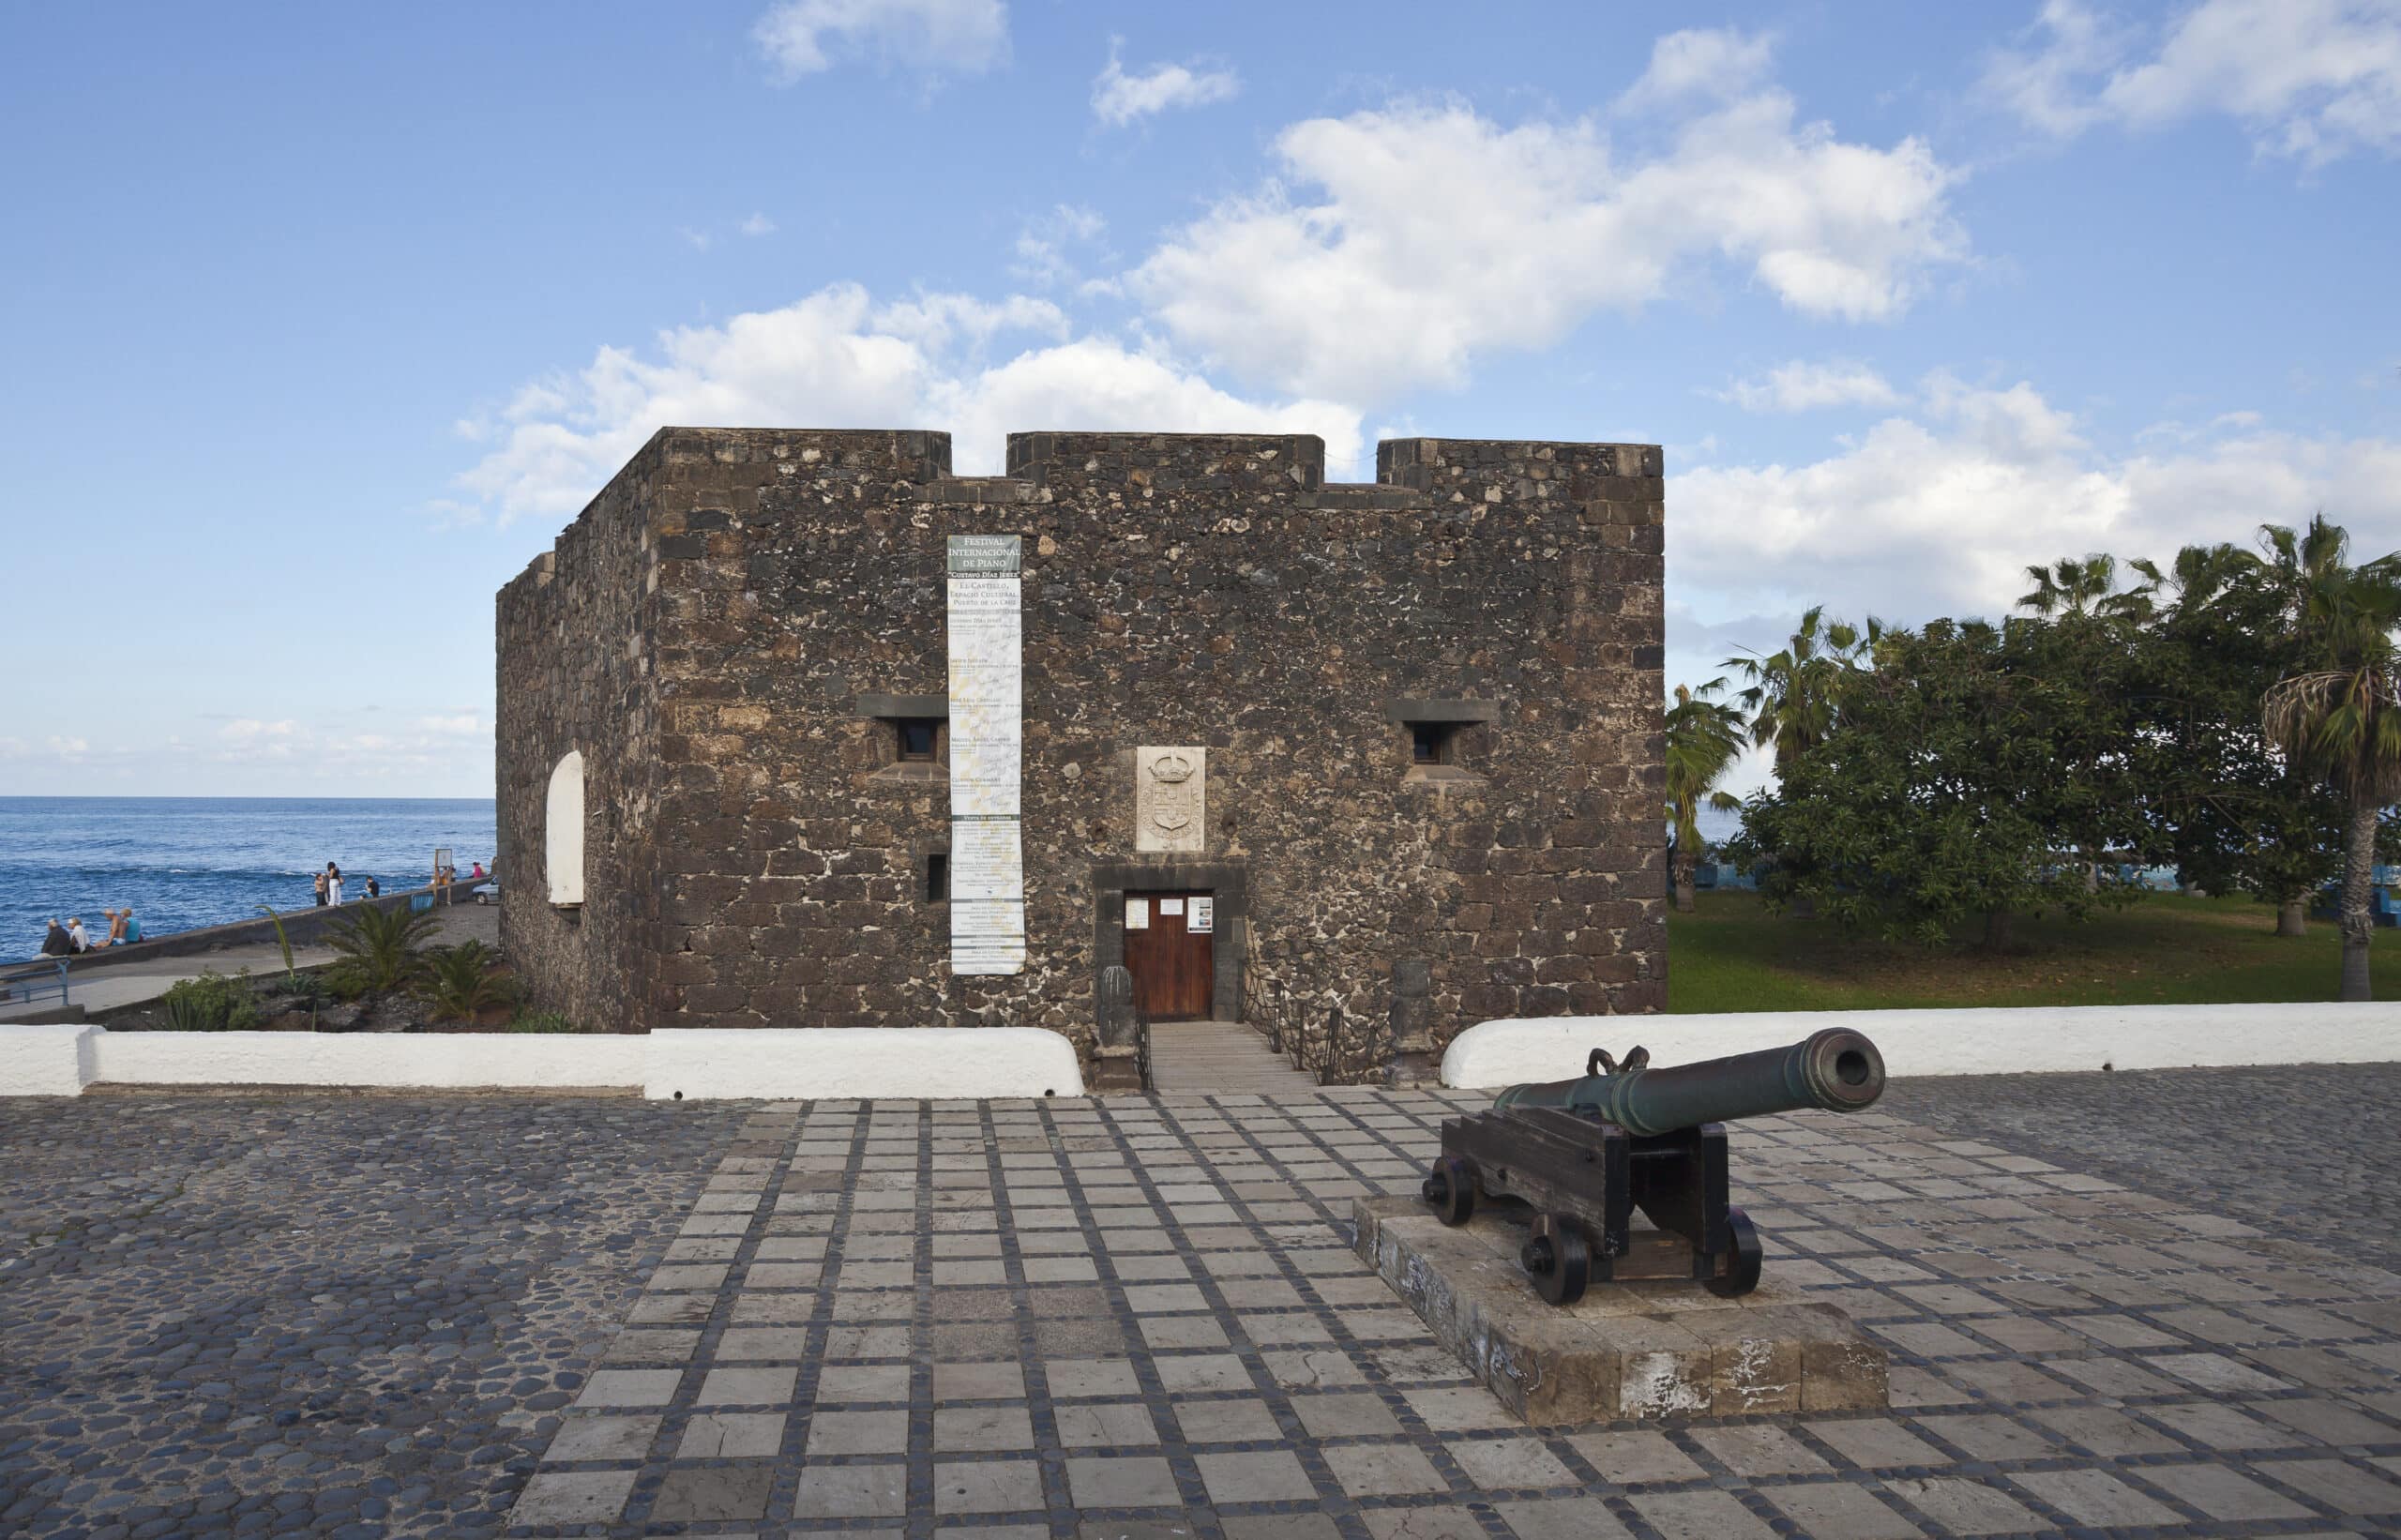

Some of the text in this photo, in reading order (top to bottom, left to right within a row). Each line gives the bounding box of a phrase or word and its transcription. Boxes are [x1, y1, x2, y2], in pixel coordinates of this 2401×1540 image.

[964, 537, 1005, 546] FESTIVAL
[948, 548, 1020, 556] INTERNACIONAL
[977, 559, 1006, 567] PIANO
